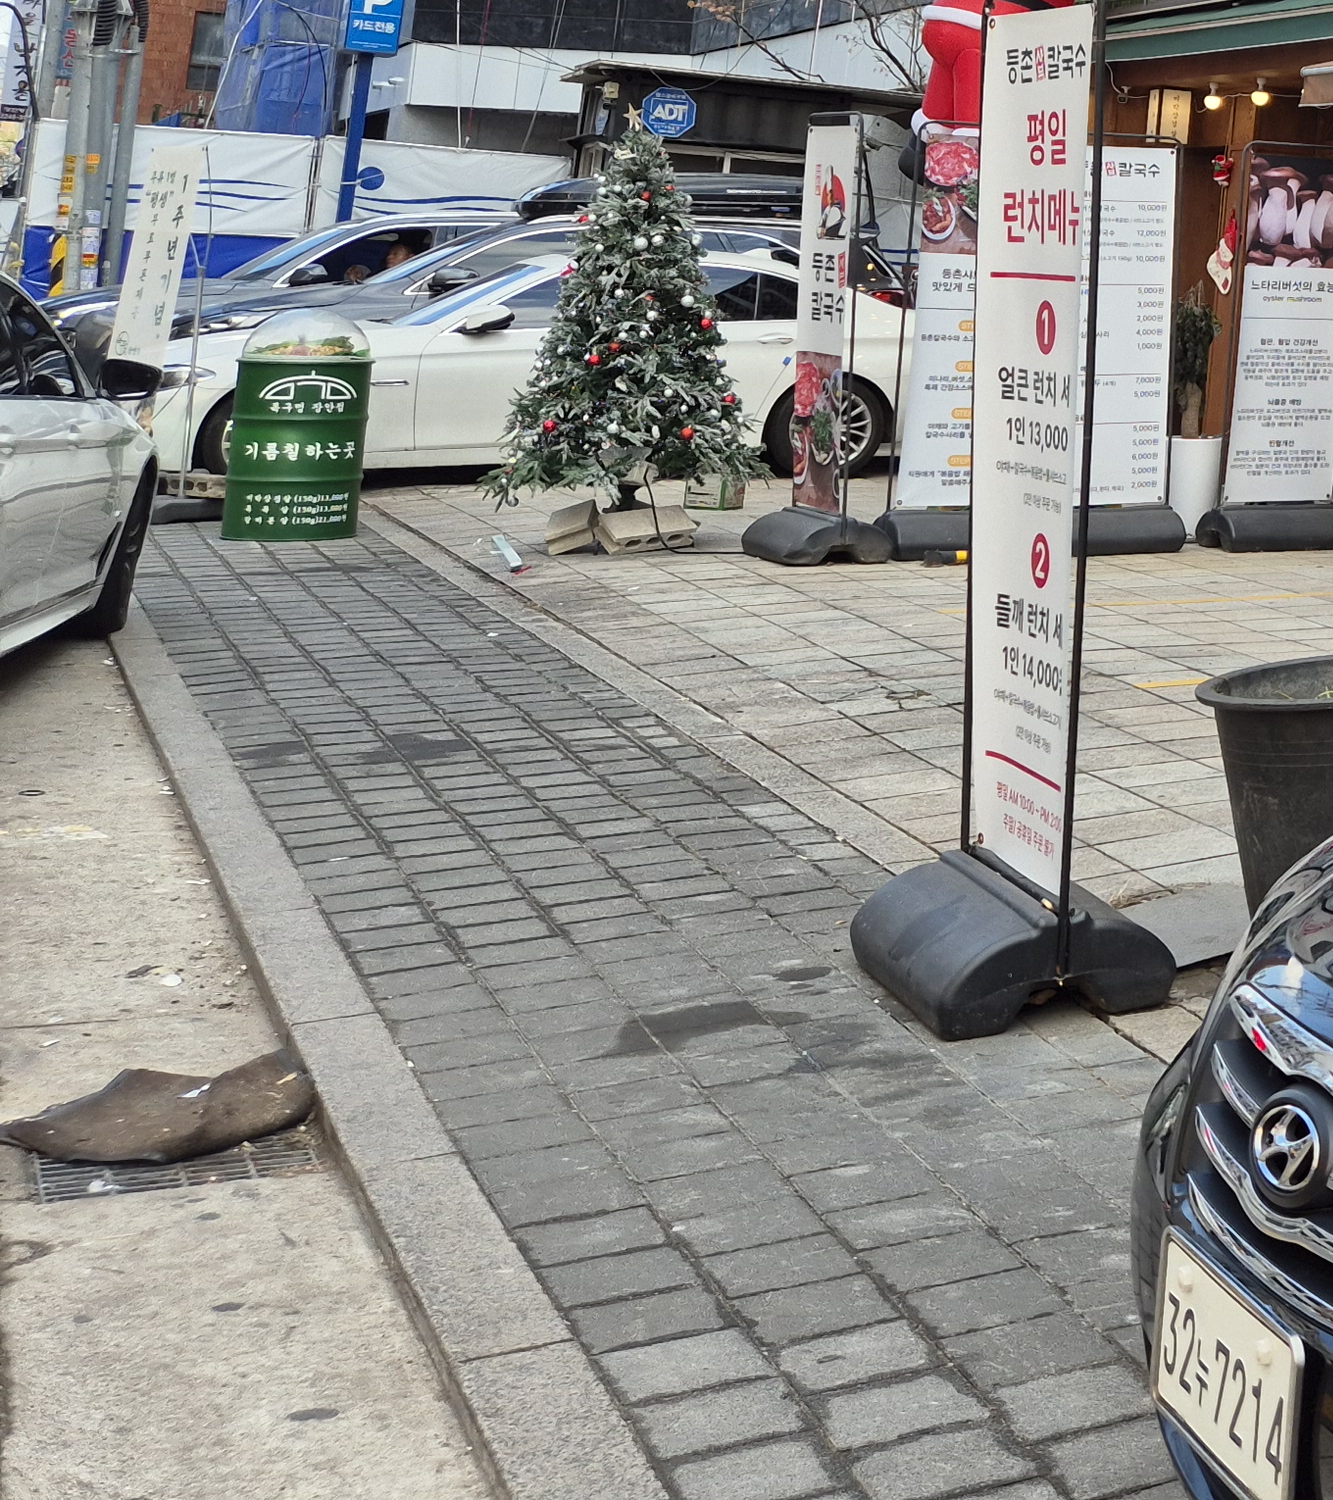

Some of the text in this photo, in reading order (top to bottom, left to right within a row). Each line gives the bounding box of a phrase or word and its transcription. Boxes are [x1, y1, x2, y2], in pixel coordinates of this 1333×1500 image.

[352, 20, 397, 34] 카드전용
[651, 103, 688, 121] ADT
[1027, 109, 1067, 166] 평일
[932, 282, 962, 292] 맛있게
[942, 269, 976, 280] 등촌샤
[1251, 280, 1312, 292] 느타리버섯의
[811, 291, 845, 324] 칼국수
[999, 366, 1057, 408] 얼큰 런치
[1007, 416, 1068, 453] 1인 13,000
[245, 441, 300, 461] 기름칠
[995, 593, 1049, 644] 들깨 런치
[1002, 646, 1063, 696] 1인 14,000
